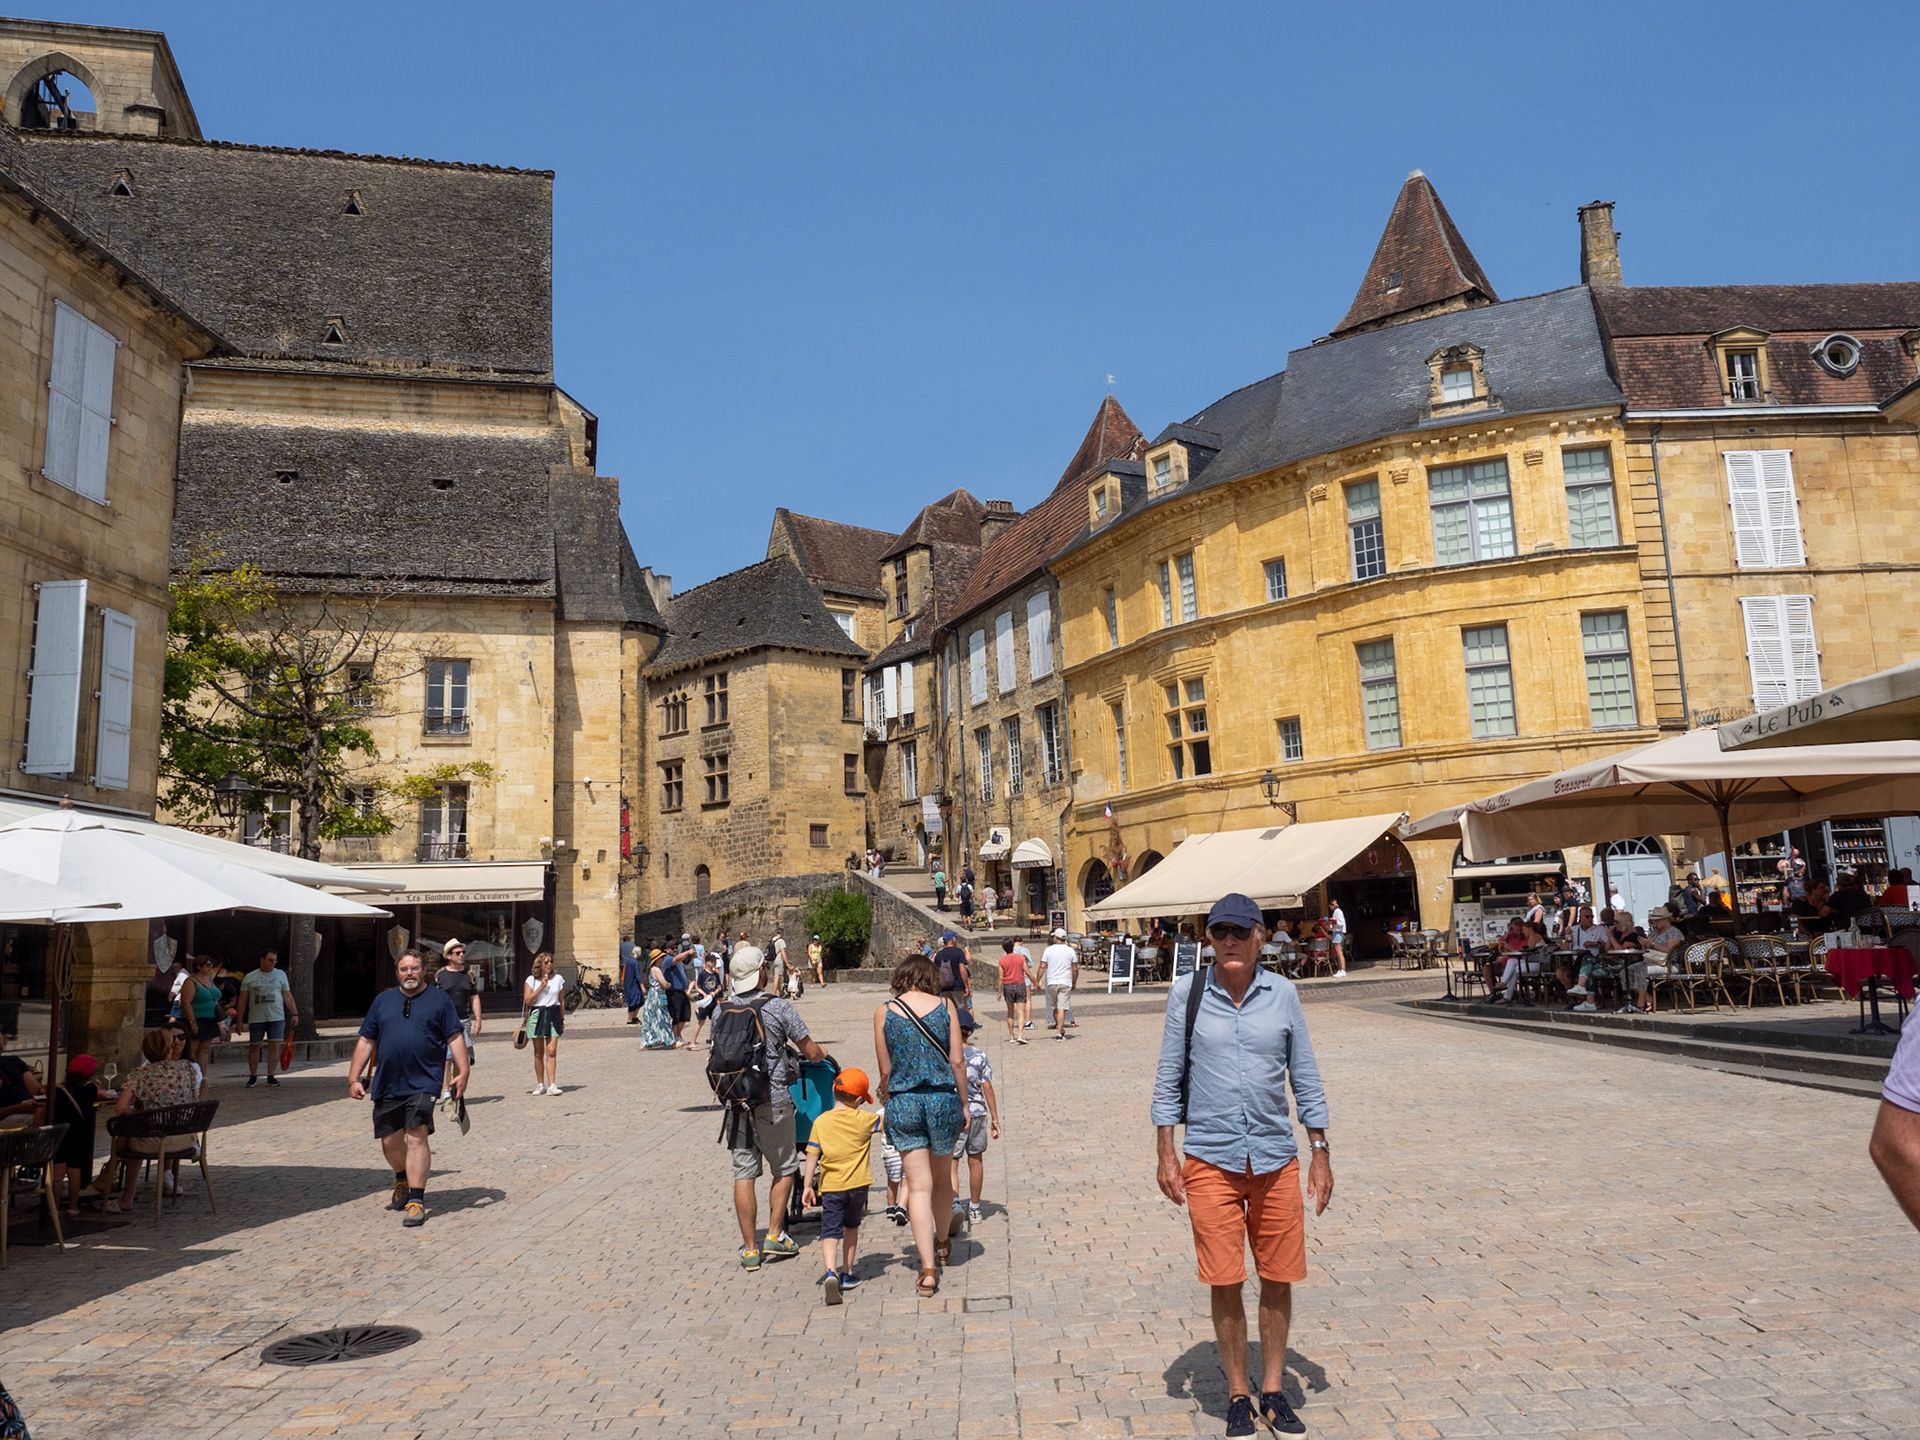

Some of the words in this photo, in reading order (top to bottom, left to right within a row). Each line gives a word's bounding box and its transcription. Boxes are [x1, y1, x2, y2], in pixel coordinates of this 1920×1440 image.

[1757, 715, 1779, 735] Le
[1786, 698, 1823, 727] Pub
[1554, 776, 1593, 794] Brasserie
[1485, 798, 1497, 812] Les
[458, 893, 470, 901] des
[473, 892, 510, 900] Chevaliers
